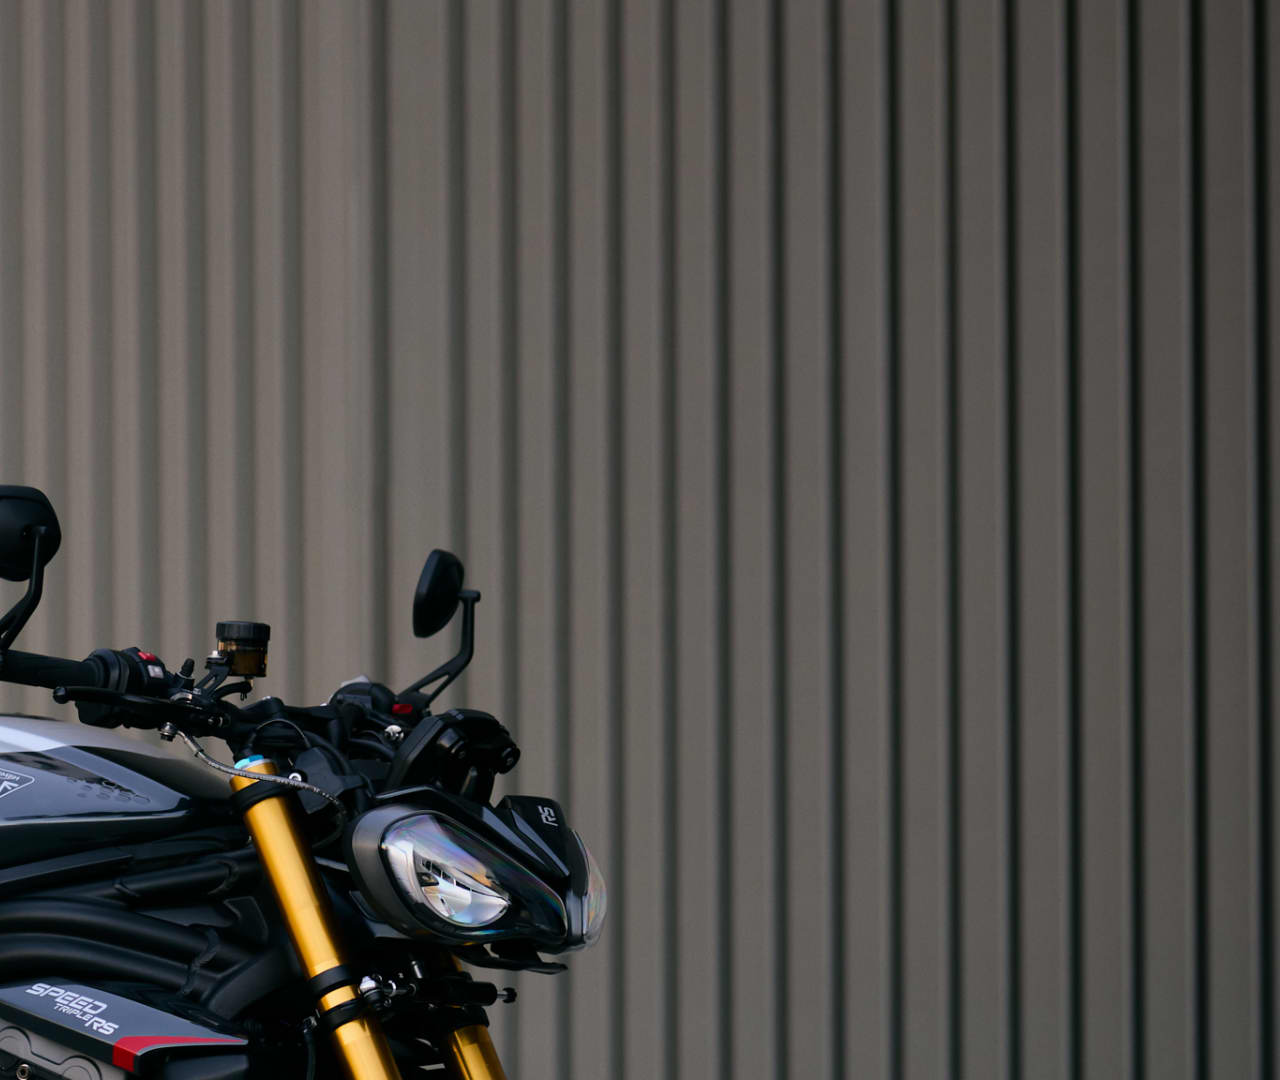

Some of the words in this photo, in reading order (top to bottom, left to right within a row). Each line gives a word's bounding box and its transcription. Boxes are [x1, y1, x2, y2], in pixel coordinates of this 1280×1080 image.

[537, 804, 559, 827] RS
[25, 982, 108, 1014] SPEED
[53, 1003, 93, 1021] TRIPLE
[84, 1016, 119, 1035] RS
